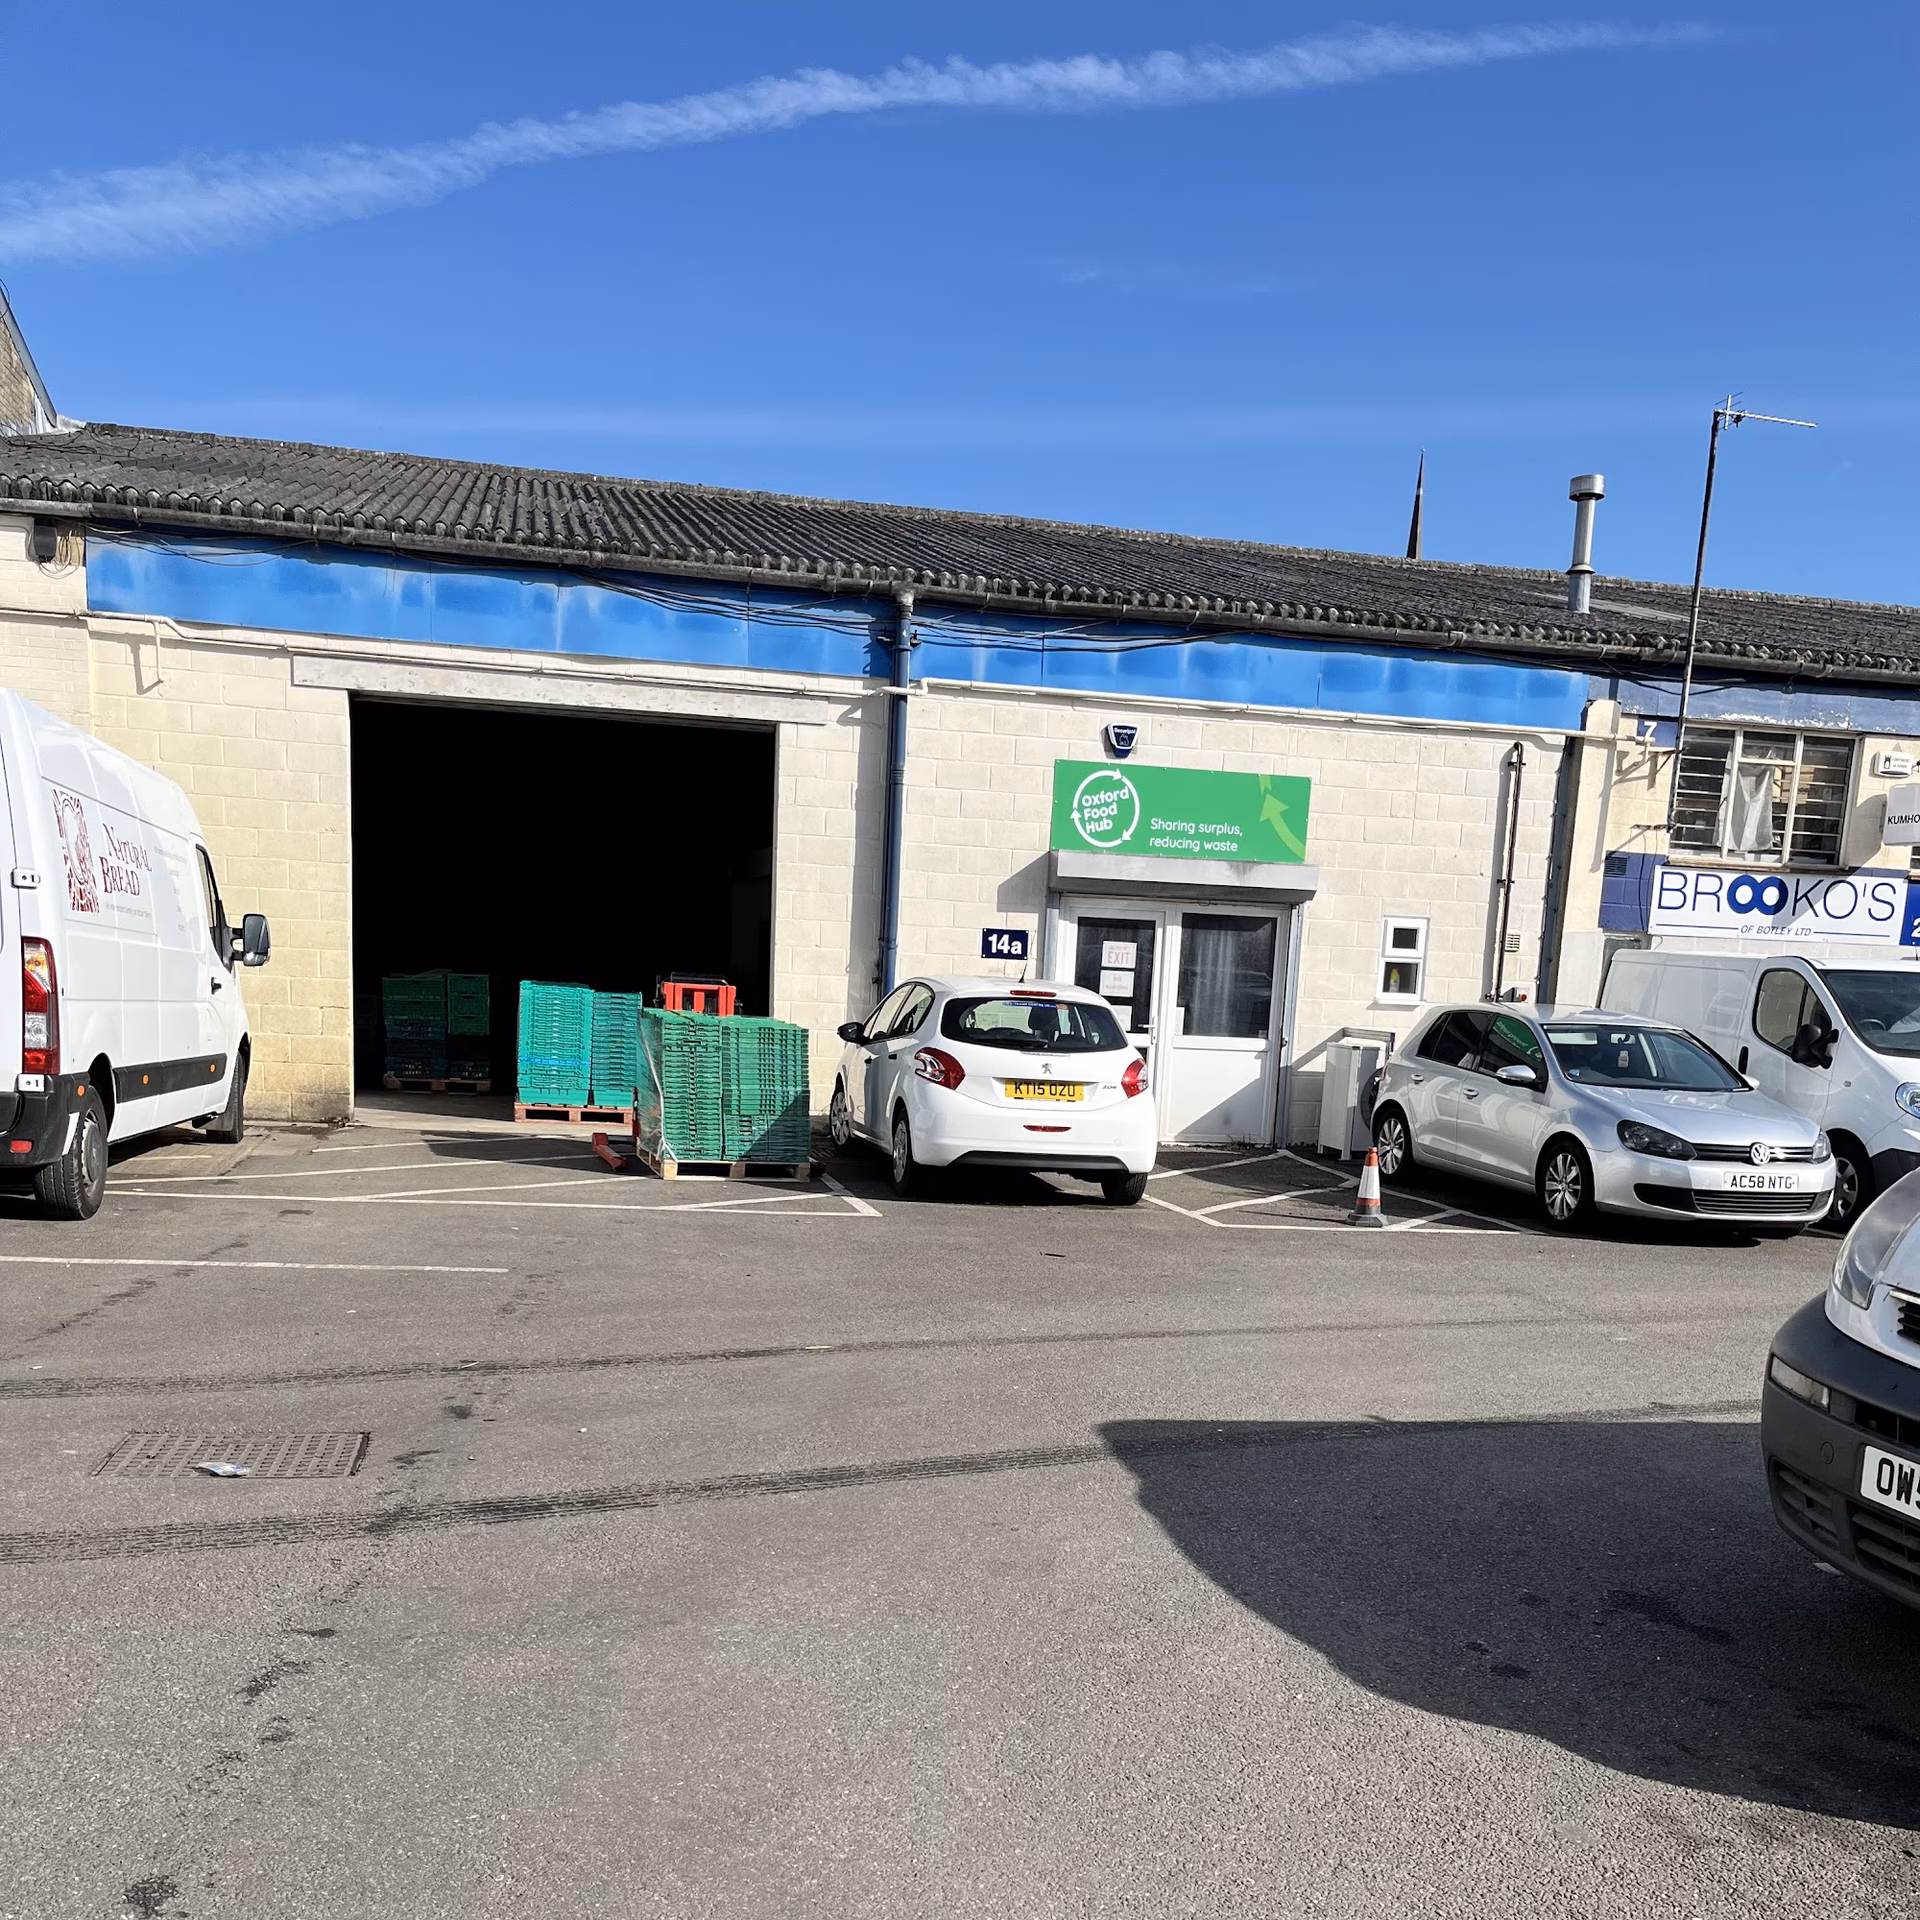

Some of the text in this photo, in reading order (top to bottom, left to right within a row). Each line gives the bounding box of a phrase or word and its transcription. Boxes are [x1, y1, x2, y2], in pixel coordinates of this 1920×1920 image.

[1644, 721, 1657, 741] 7
[1081, 786, 1130, 808] Oxford
[1083, 803, 1118, 821] Food
[1887, 814, 1920, 825] KUMHO
[1085, 818, 1113, 834] Hub
[1150, 817, 1243, 837] Sharing surplus,
[1149, 836, 1239, 852] reducing waste
[1657, 871, 1897, 922] BROOKO'S
[1740, 925, 1812, 937] OF BOTLEY LTD
[988, 933, 1023, 955] 14a
[1107, 951, 1131, 965] EXIT
[1014, 1081, 1076, 1097] KT15 OZU
[1730, 1175, 1792, 1189] AC58 NTG
